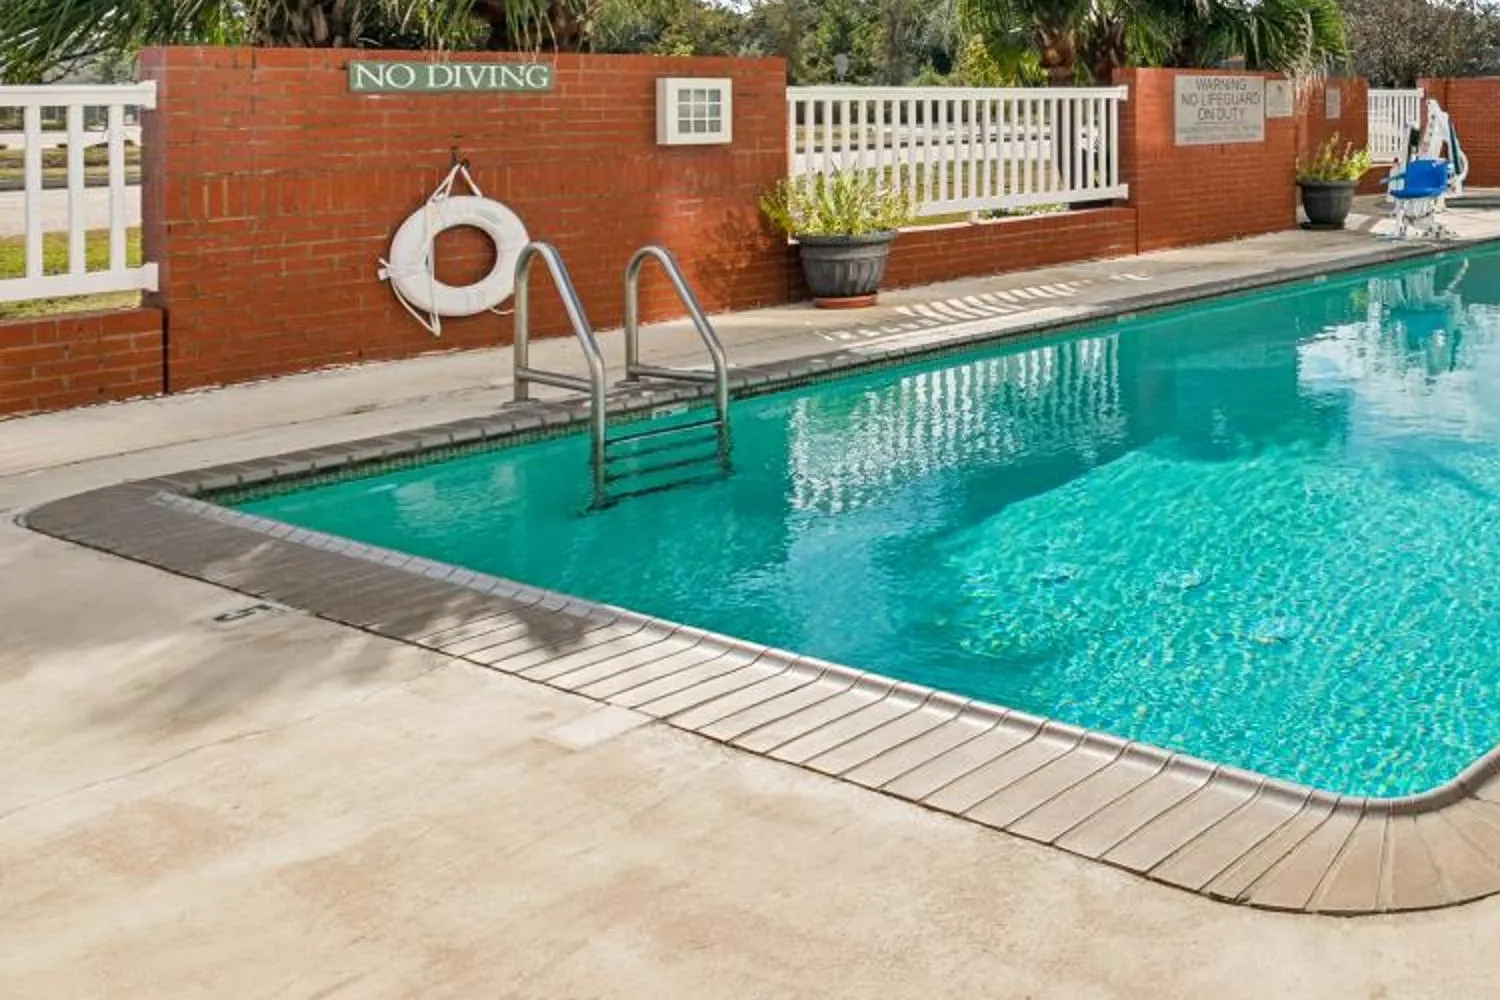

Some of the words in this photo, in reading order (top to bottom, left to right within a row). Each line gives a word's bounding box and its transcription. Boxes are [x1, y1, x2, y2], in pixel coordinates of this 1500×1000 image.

[354, 63, 416, 88] NO
[427, 64, 549, 88] DIVING
[1195, 77, 1248, 91] WARNING
[1180, 91, 1199, 107] NO
[1201, 91, 1261, 106] LIFEGUARD
[1197, 107, 1214, 121] ON
[1216, 107, 1246, 120] DUTY
